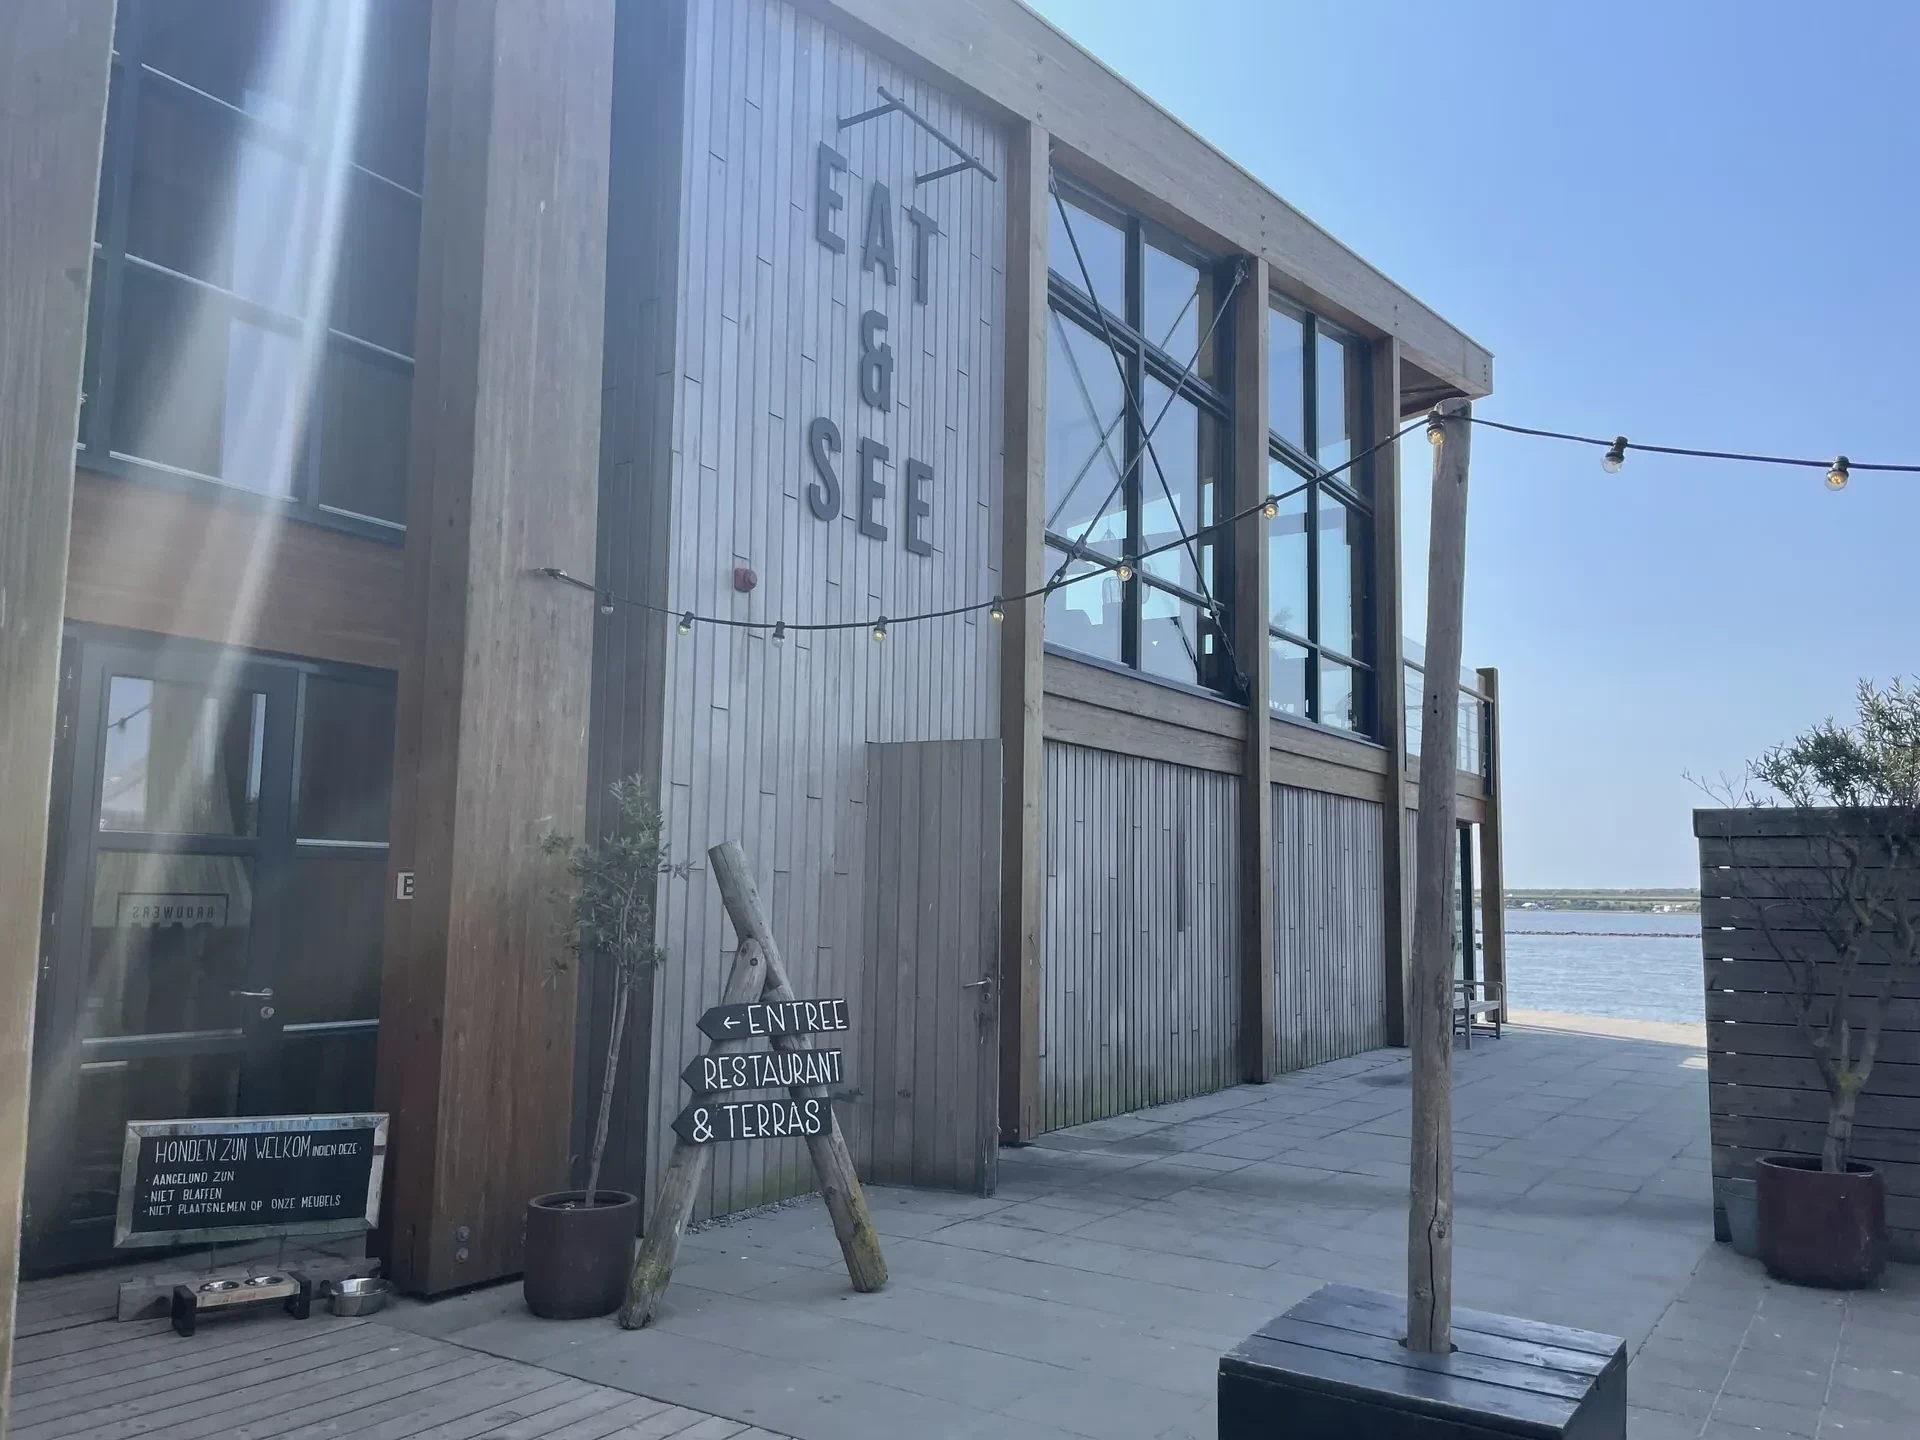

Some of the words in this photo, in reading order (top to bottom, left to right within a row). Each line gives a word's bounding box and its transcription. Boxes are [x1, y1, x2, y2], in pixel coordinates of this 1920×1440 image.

[816, 140, 939, 306] EAT
[861, 310, 894, 412] &
[809, 416, 934, 558] SEE
[747, 1000, 848, 1034] ENTREE
[703, 1051, 842, 1090] RESTAURANT
[692, 1107, 715, 1142] &
[723, 1099, 821, 1138] TERRAS
[155, 1139, 218, 1164] HONDEN
[254, 1135, 311, 1159] WELKOM
[178, 1201, 247, 1215] PLAATSNEMEN
[250, 1200, 263, 1211] OP
[271, 1197, 296, 1210] ONZE
[301, 1194, 341, 1208] MEUBELS
[182, 1187, 222, 1201] BLAFFEN
